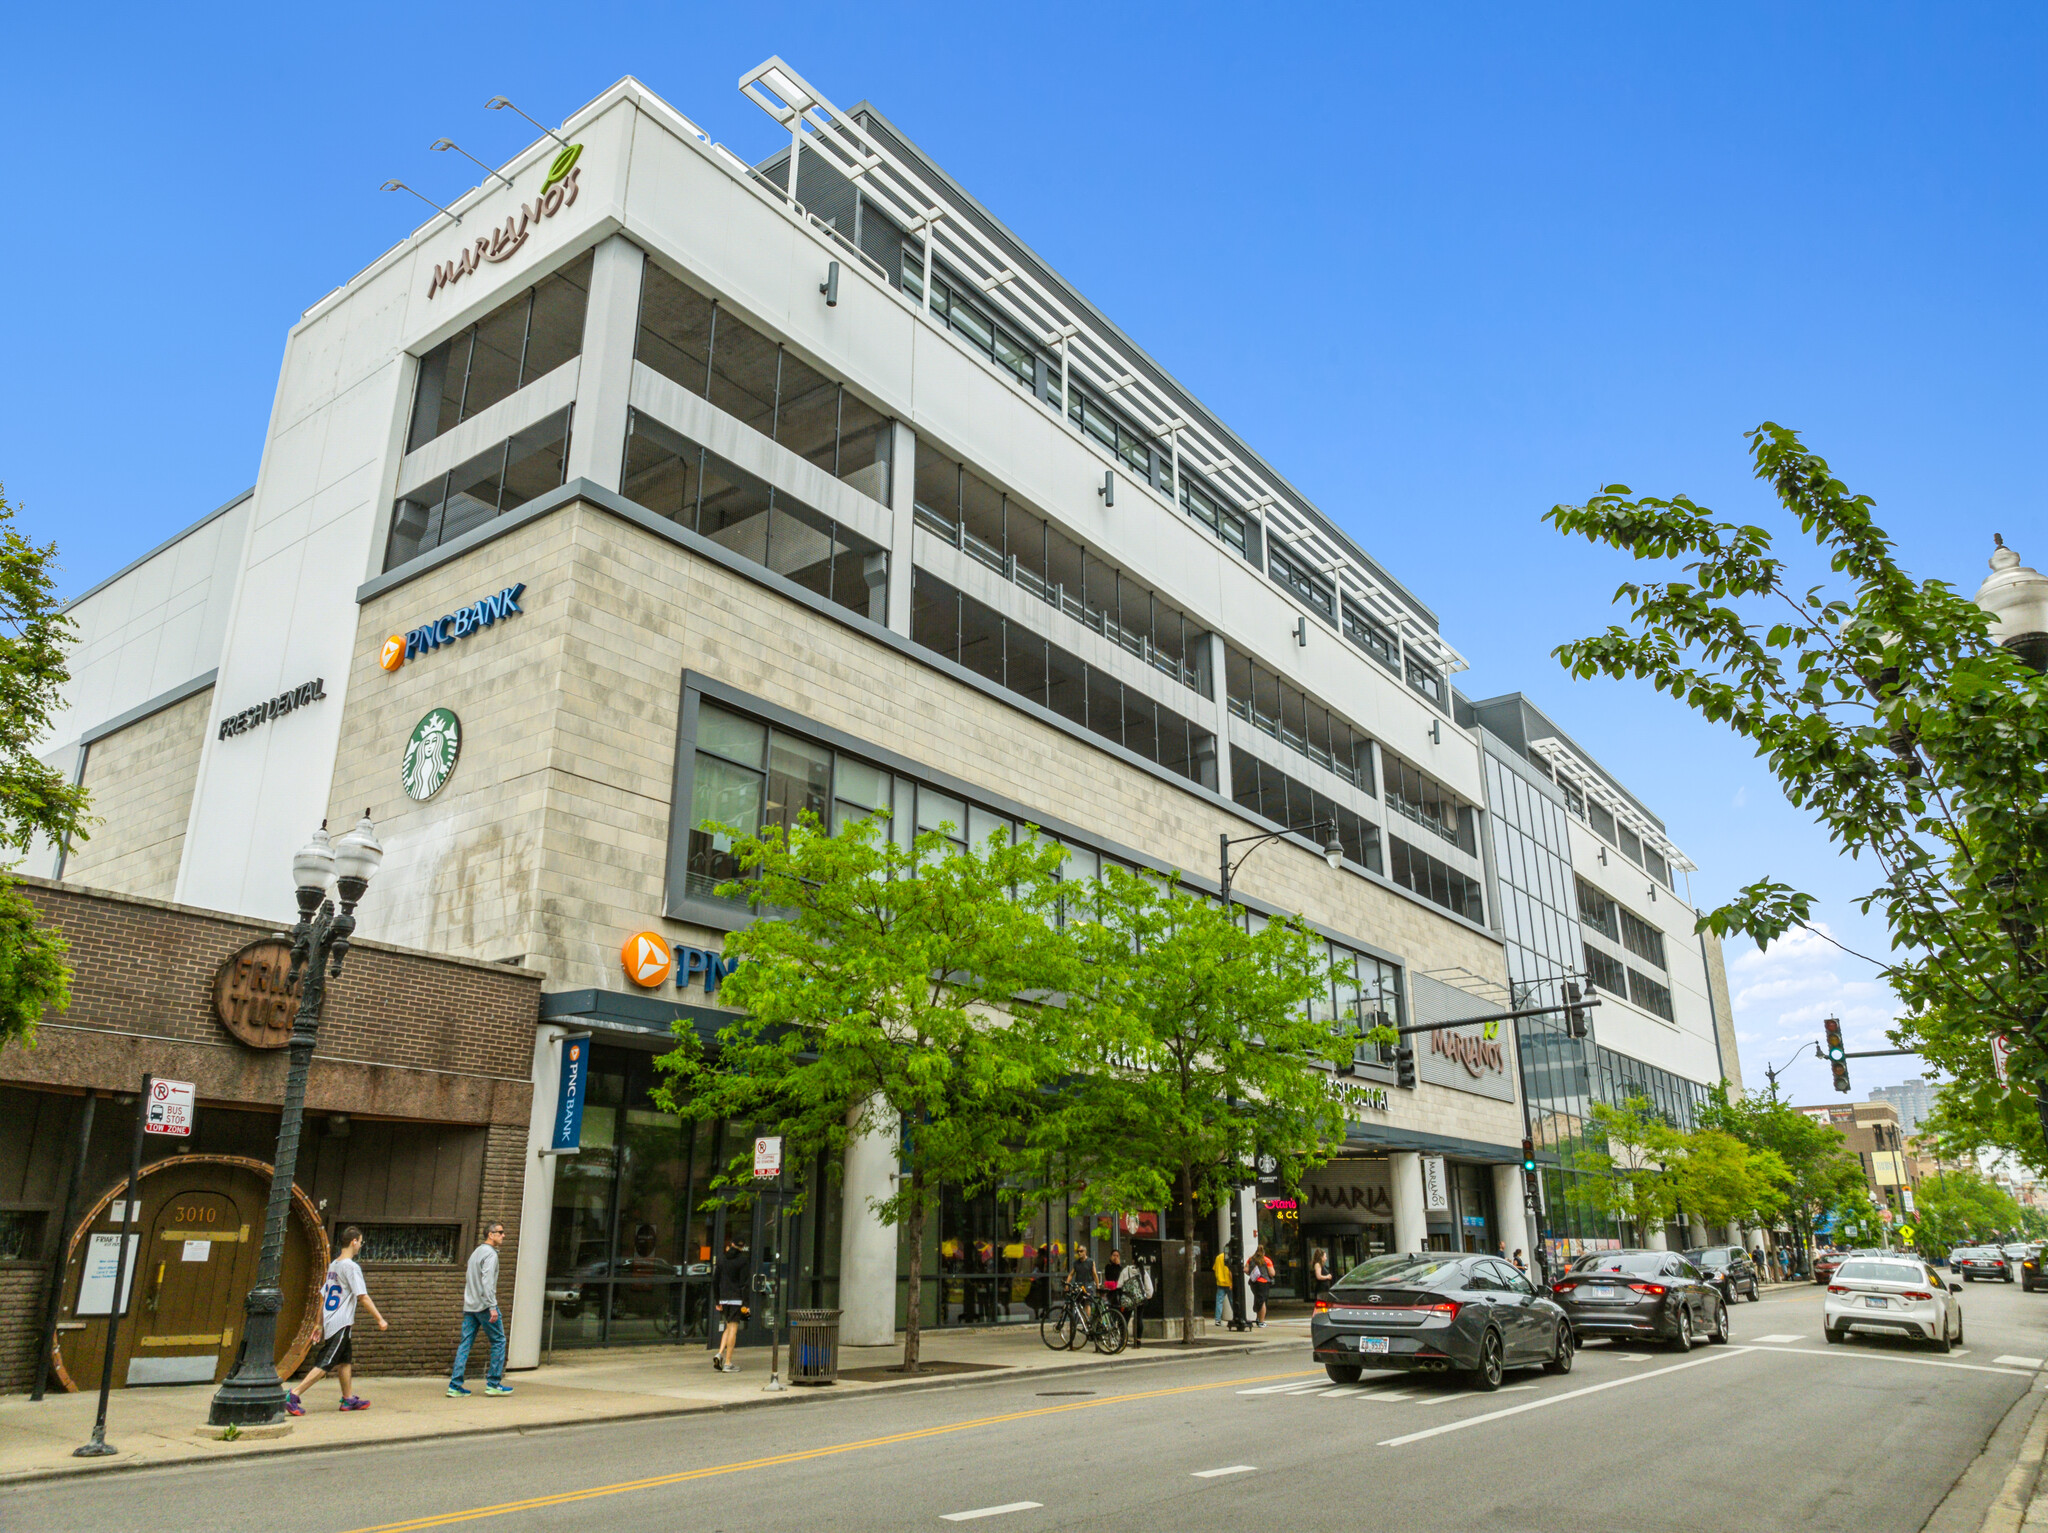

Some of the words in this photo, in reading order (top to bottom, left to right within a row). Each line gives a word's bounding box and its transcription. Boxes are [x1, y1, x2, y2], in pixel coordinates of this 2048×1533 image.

[427, 166, 581, 300] MARIANO'S
[218, 701, 269, 741] FRESH
[267, 677, 327, 720] DENTAL
[167, 1105, 183, 1116] BUS
[166, 1114, 186, 1125] STOP
[149, 1123, 165, 1132] TOW
[167, 1125, 187, 1134] ZONE
[174, 1206, 216, 1223] 3010
[1276, 1210, 1284, 1219] &
